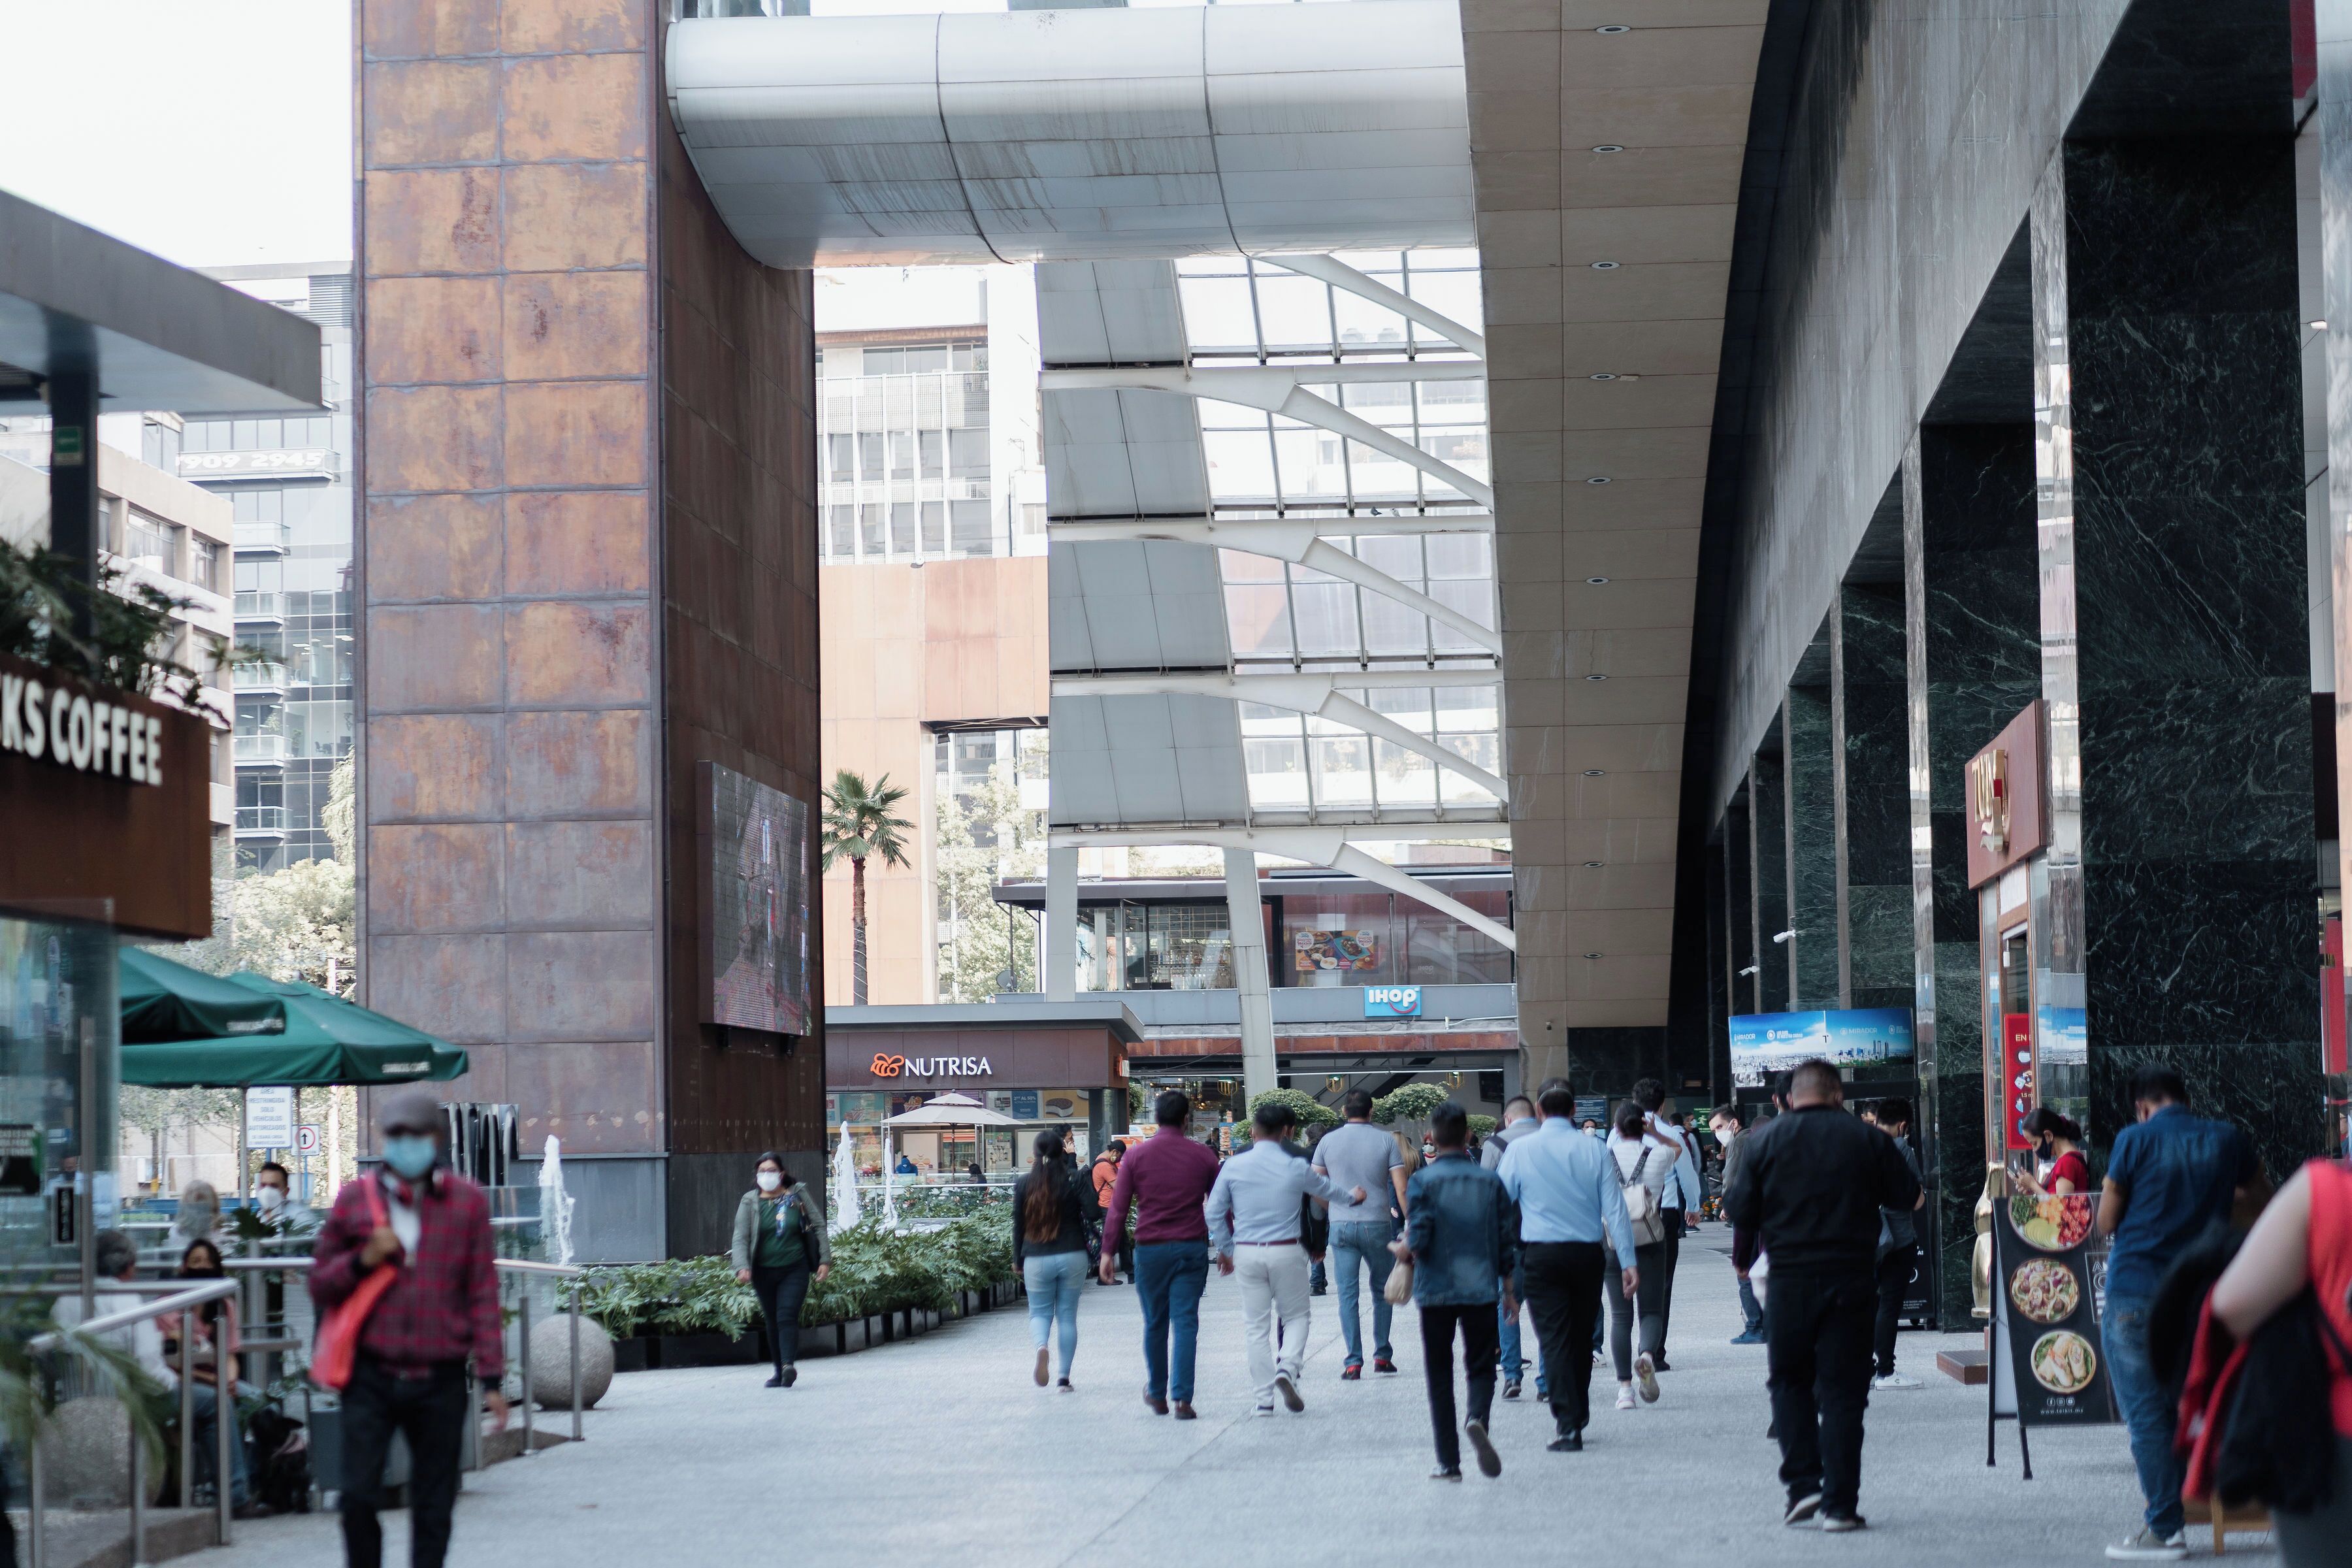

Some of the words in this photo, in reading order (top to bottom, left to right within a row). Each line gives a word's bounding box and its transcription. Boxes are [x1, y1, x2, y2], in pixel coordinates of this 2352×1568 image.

[251, 452, 321, 467] 2945
[50, 687, 162, 786] COFFEE
[1369, 988, 1417, 1007] IHOP
[905, 1056, 992, 1077] NUTRISA
[1632, 1156, 1646, 1178] GUESS
